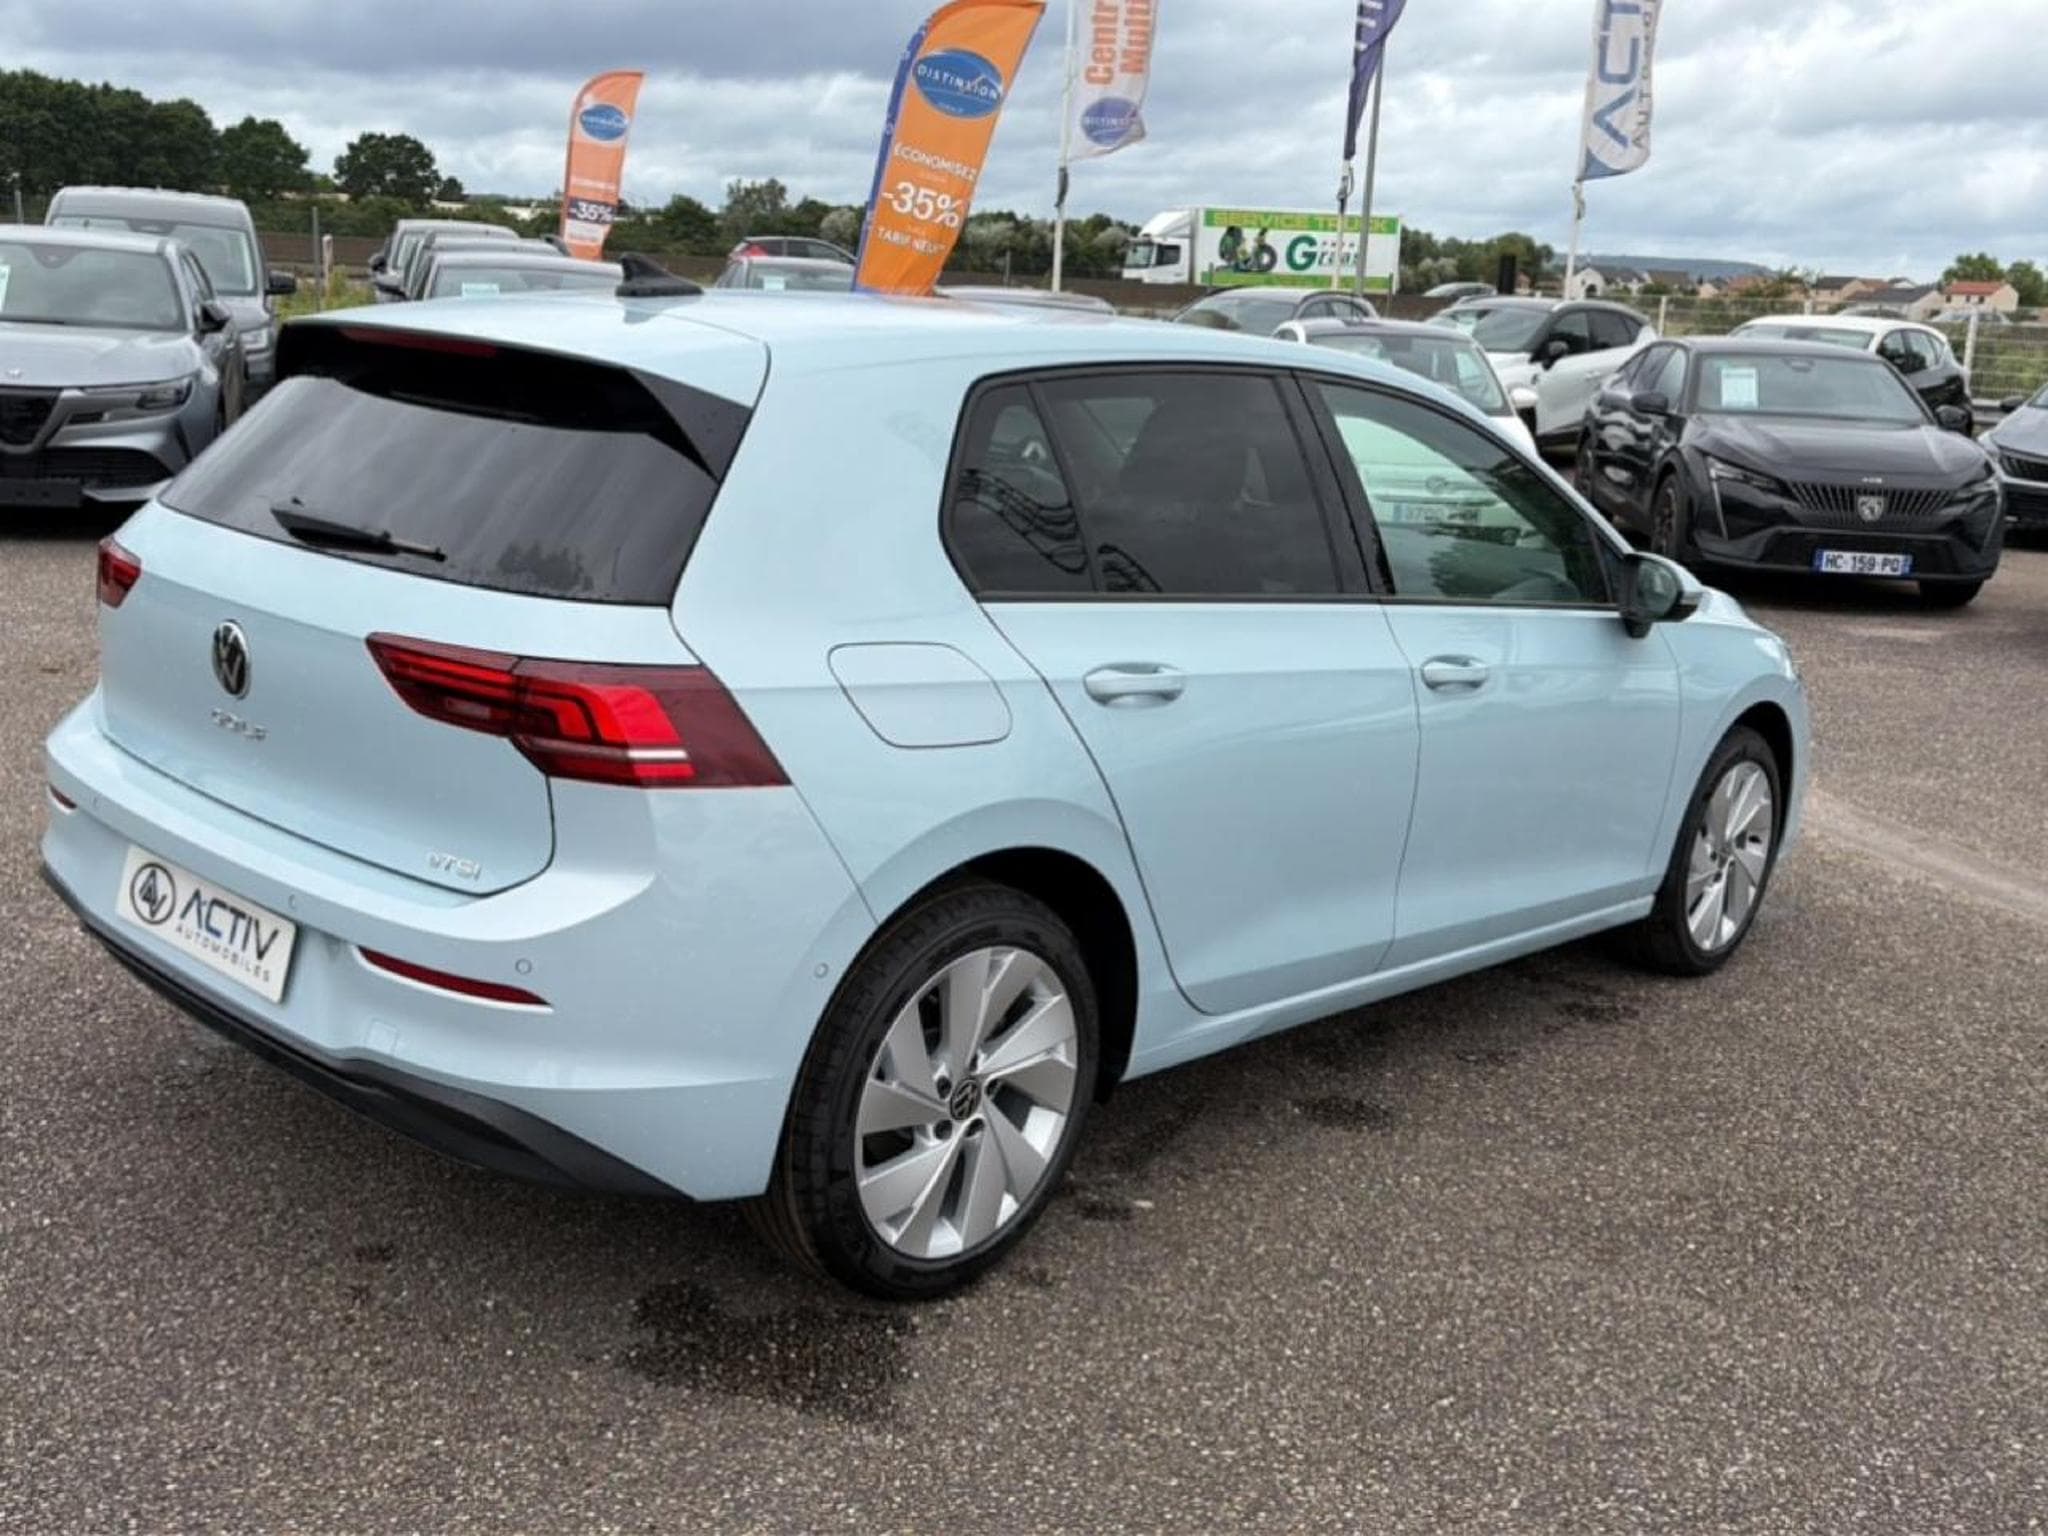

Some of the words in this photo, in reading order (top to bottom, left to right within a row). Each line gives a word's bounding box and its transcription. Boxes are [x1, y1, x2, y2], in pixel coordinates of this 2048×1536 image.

[881, 181, 962, 228] -35%
[179, 887, 279, 960] ACTIV
[175, 925, 270, 983] AUTOMOBILES
